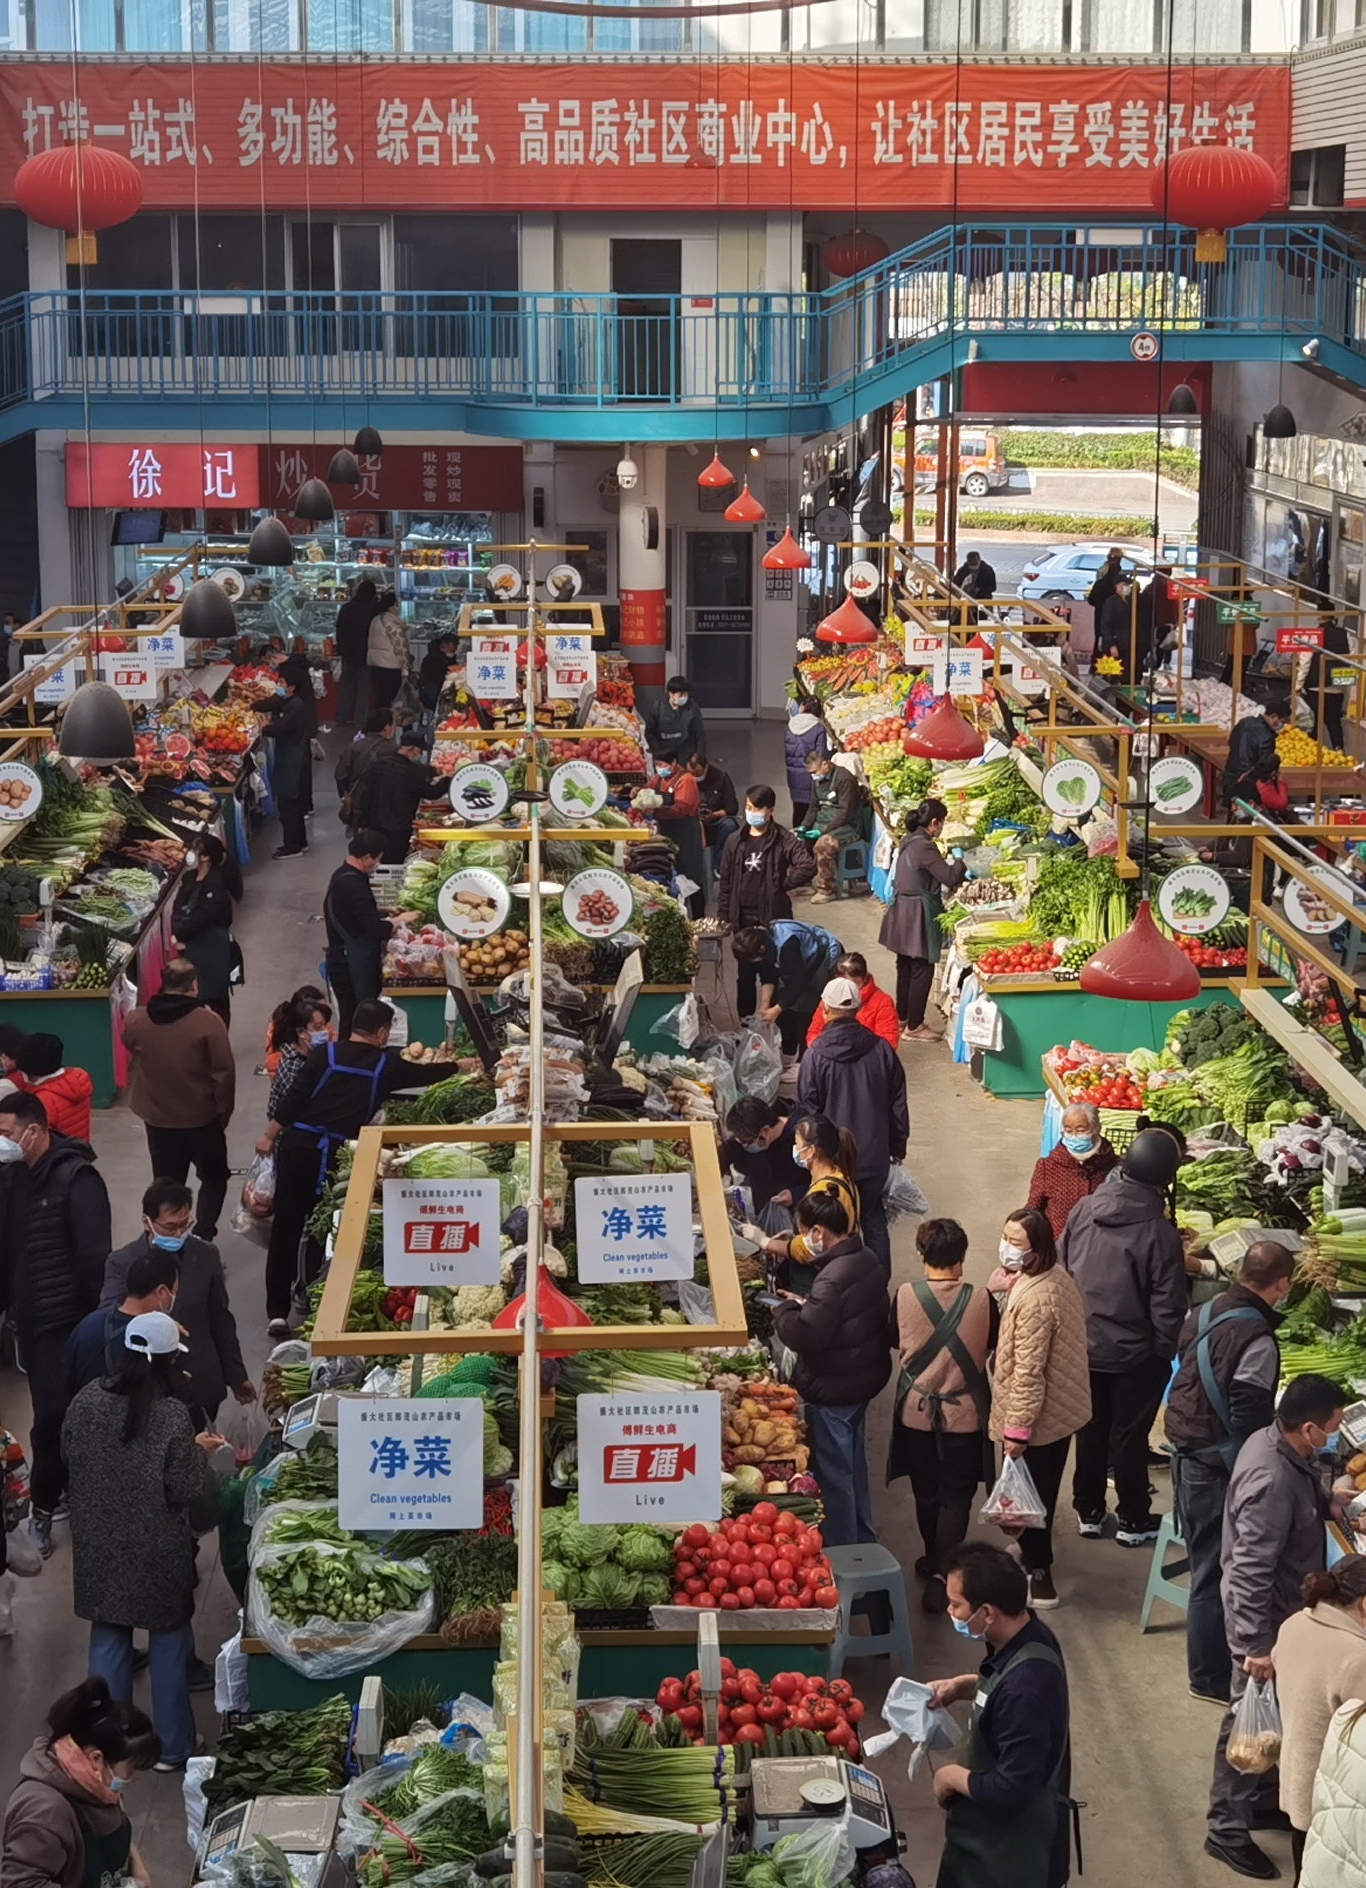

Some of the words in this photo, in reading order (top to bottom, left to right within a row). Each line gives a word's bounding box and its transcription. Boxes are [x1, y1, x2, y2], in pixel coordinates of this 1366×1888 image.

[147, 637, 175, 651] 净菜
[554, 636, 581, 650] 净菜
[477, 665, 506, 682] 净菜
[944, 661, 972, 678] 净菜
[601, 1204, 668, 1241] 净菜
[408, 1223, 467, 1251] 直播
[602, 1253, 625, 1262] Clean
[625, 1251, 669, 1263] vegetables
[429, 1262, 455, 1273] Live
[368, 1435, 453, 1480] 净菜
[609, 1446, 679, 1481] 直播
[369, 1493, 398, 1504] Clean
[399, 1492, 453, 1506] vegetables
[635, 1494, 666, 1506] Live
